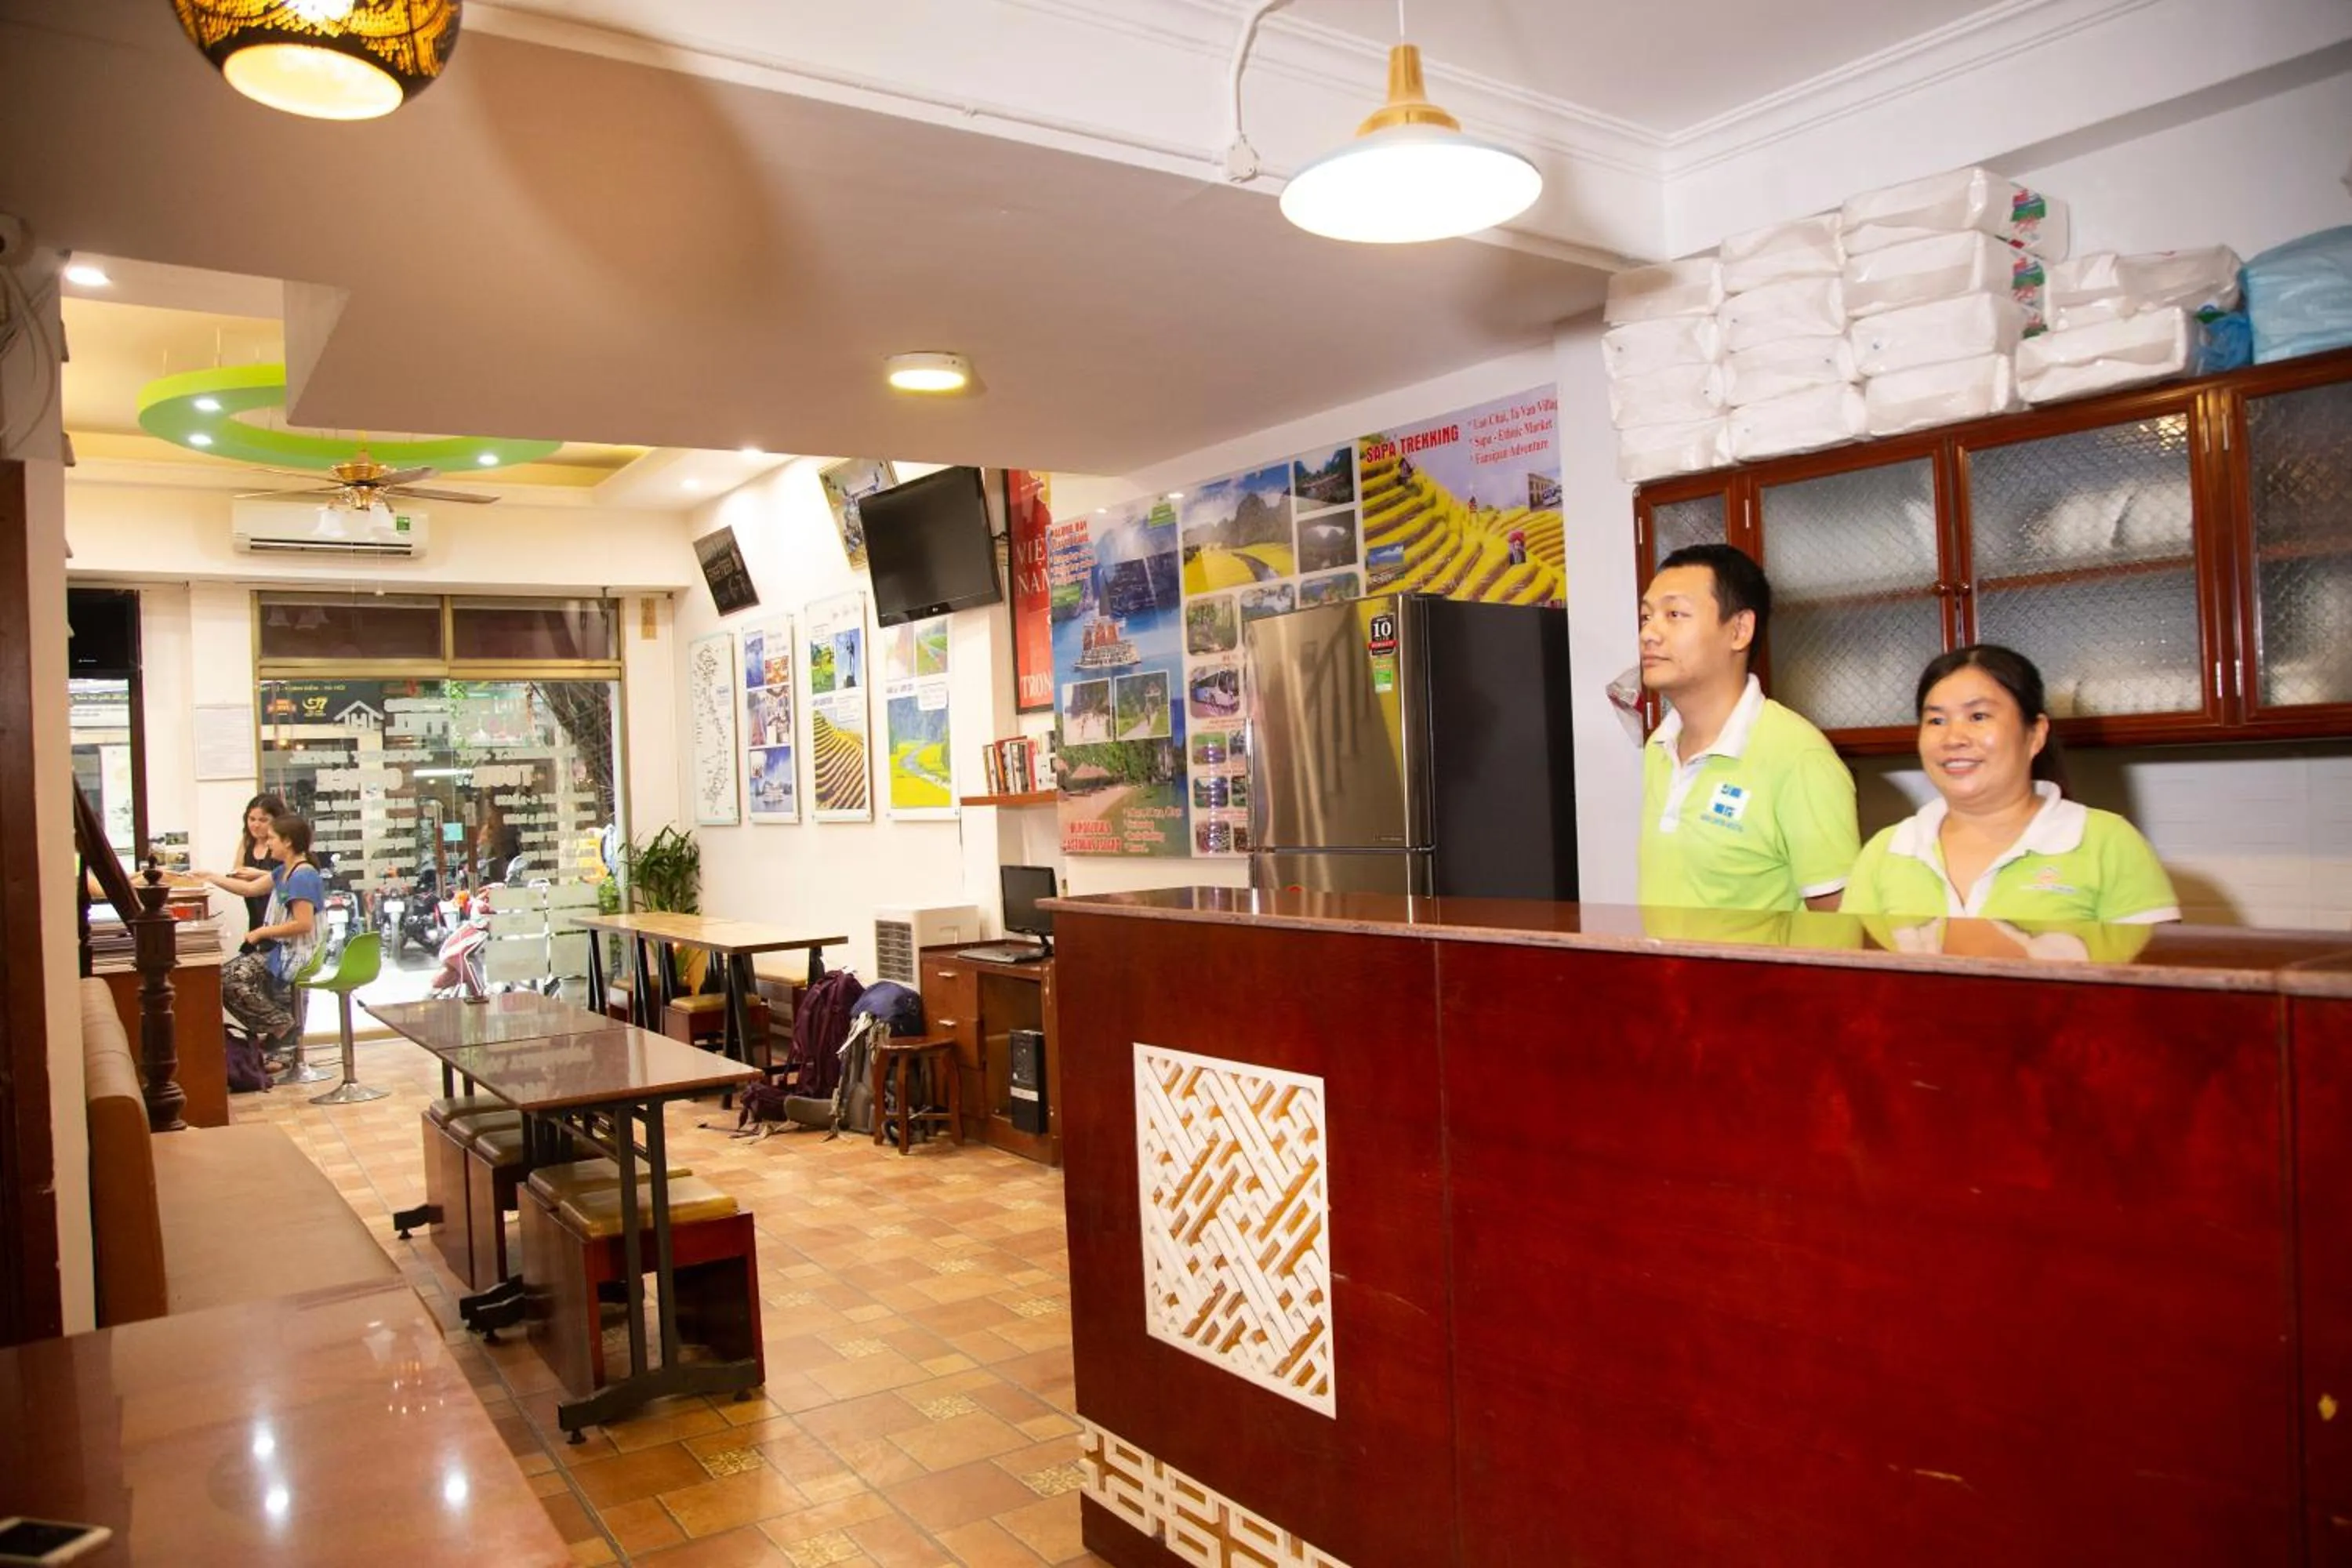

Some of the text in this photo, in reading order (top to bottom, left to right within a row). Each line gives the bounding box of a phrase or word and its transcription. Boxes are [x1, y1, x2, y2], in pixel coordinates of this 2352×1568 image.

[1367, 424, 1459, 463] SAPA TREKKING
[1373, 621, 1392, 638] 10
